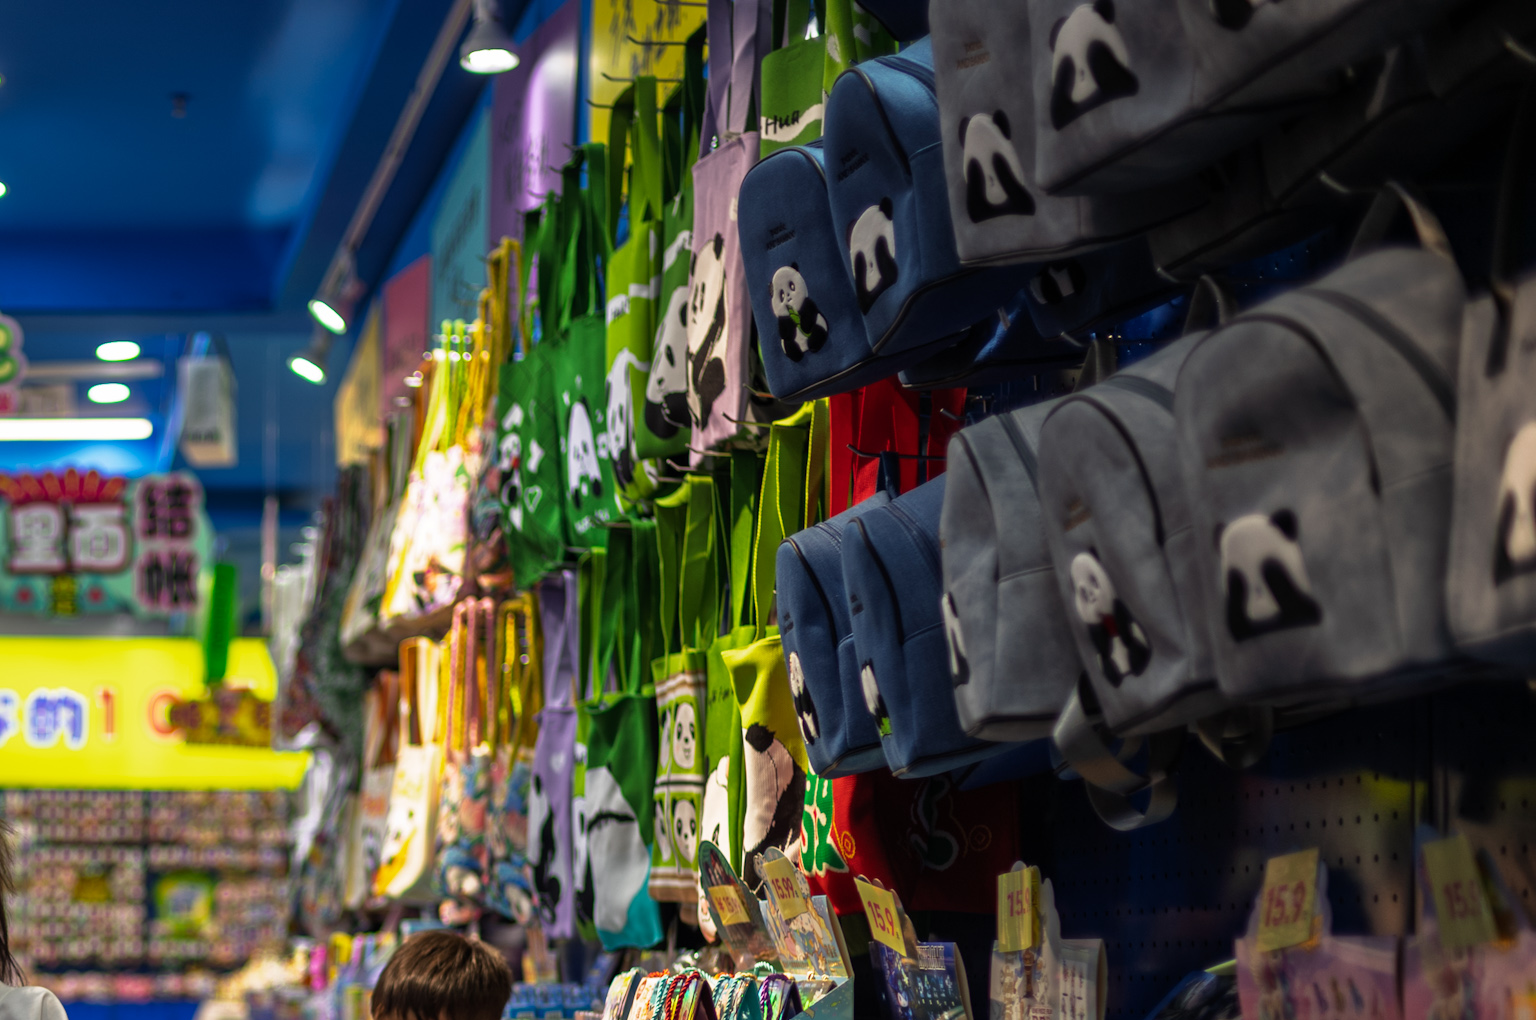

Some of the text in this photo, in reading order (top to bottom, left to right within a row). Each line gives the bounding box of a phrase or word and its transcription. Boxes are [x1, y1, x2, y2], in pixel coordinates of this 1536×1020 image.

[771, 876, 796, 900] 15.99
[1265, 880, 1306, 928] 15.9
[867, 900, 895, 937] 15.9
